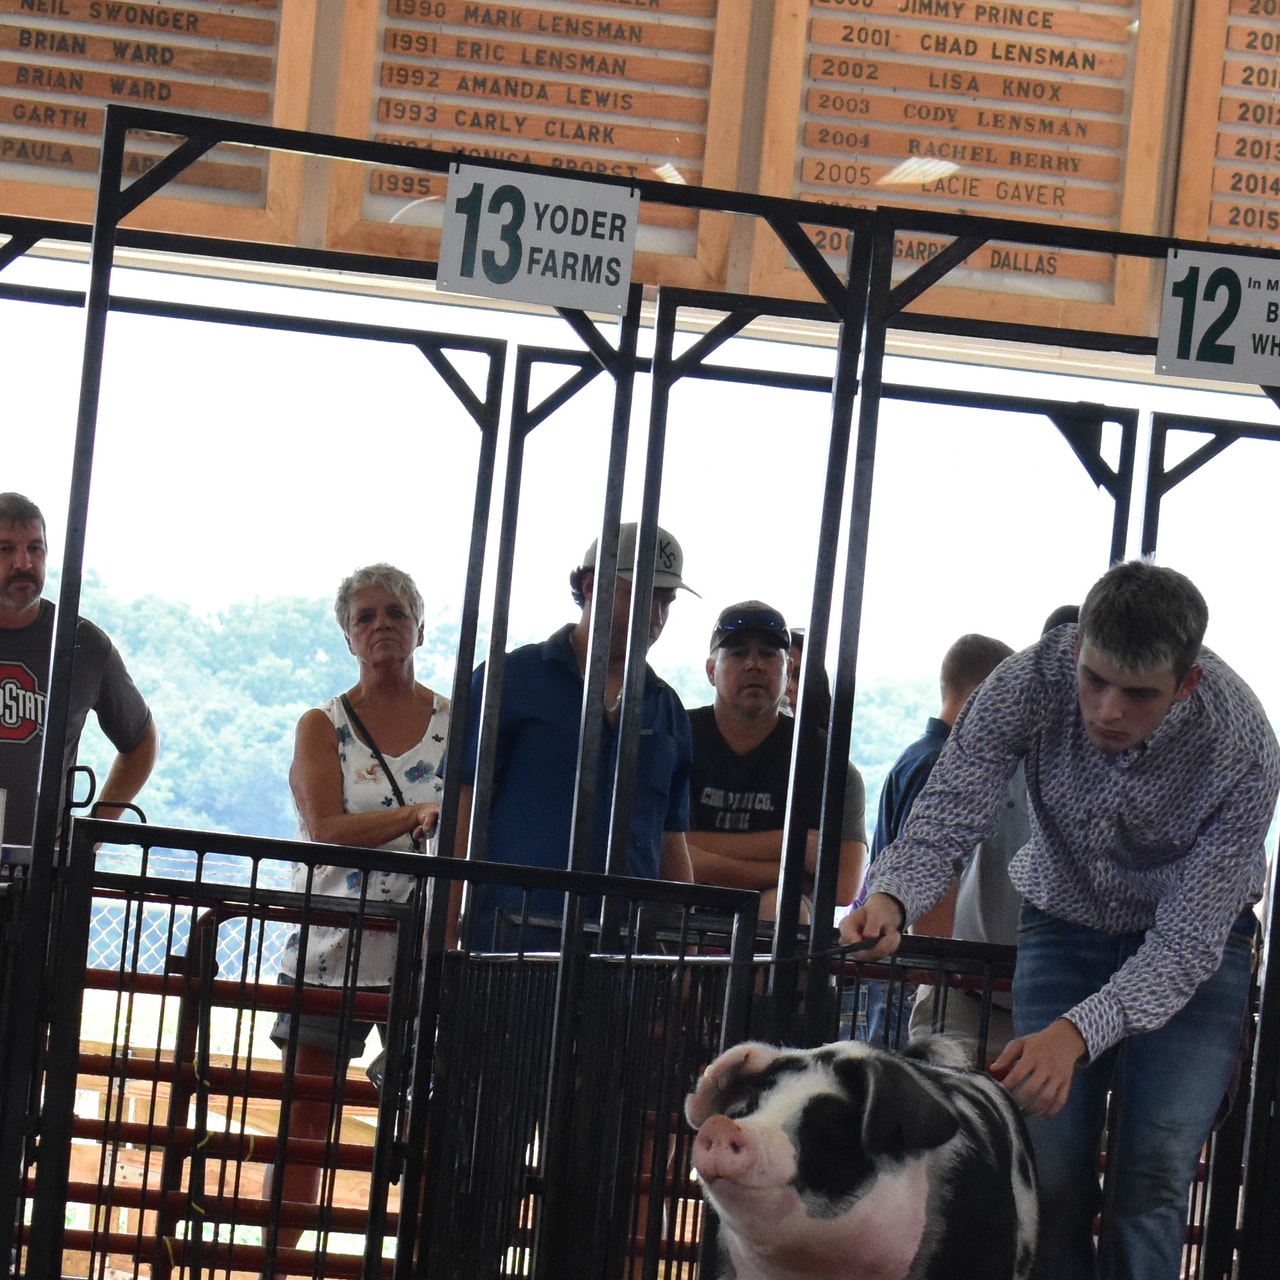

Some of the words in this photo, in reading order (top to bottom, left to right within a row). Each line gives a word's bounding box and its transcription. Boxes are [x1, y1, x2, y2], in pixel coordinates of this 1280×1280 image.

[21, 0, 70, 16] NEIL
[89, 3, 199, 31] SWONGER
[394, 0, 446, 19] 1990
[464, 6, 521, 28] MARK
[538, 16, 643, 43] LENSMAN
[898, 0, 965, 18] JIMMY
[975, 6, 1055, 30] PRINCE
[19, 30, 87, 54] BRIAN
[112, 42, 175, 65] WARD
[391, 33, 438, 55] 1991
[455, 40, 504, 62] ERIC
[521, 48, 627, 76] LENSMAN
[841, 26, 891, 47] 2001
[920, 35, 978, 57] CHAD
[991, 41, 1097, 71] LENSMAN
[16, 67, 84, 90] BRIAN
[109, 77, 172, 101] WARD
[387, 66, 440, 88] 1992
[456, 75, 549, 101] AMANDA
[566, 87, 634, 111] LEWIS
[821, 59, 880, 81] 2002
[928, 71, 980, 92] LISA
[1002, 78, 1063, 101] KNOX
[12, 104, 88, 128] GARTH
[383, 101, 438, 123] 1993
[455, 110, 527, 133] CARLY
[545, 121, 614, 145] CLARK
[819, 95, 870, 114] 2003
[903, 103, 959, 124] CODY
[977, 111, 1088, 138] LENSMAN
[1, 140, 74, 164] PAULA
[819, 129, 871, 149] 2004
[909, 139, 998, 164] RACHEL
[1009, 150, 1083, 173] BERRY
[377, 173, 431, 195] 1995
[814, 161, 872, 185] 2005
[922, 175, 981, 198] LACIE
[996, 182, 1066, 207] GAVER
[455, 182, 526, 285] 13
[533, 202, 627, 243] YODER
[1228, 207, 1280, 231] 2015
[526, 246, 622, 287] FARMS
[814, 230, 849, 252] 20
[990, 251, 1058, 276] DALLAS
[1248, 277, 1262, 291] In
[1171, 265, 1243, 365] 12
